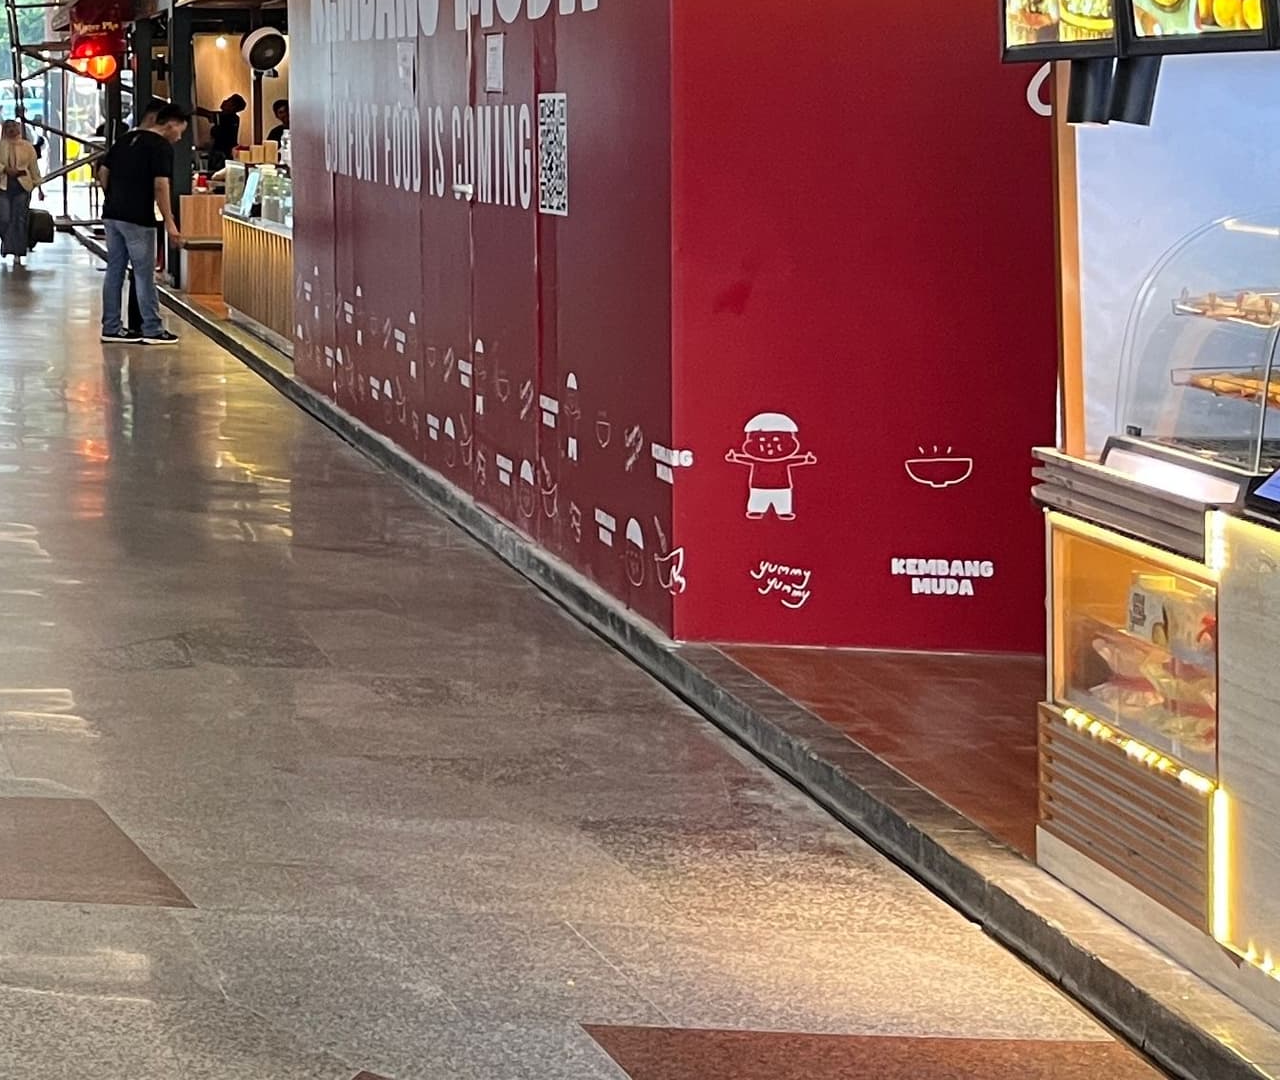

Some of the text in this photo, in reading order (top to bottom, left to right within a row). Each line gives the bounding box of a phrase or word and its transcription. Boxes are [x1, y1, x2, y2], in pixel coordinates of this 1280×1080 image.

[324, 101, 532, 210] COMFORT FOOD IS COMING
[750, 560, 811, 590] yummy
[891, 558, 994, 577] KEMBANG
[758, 577, 811, 609] yummy
[911, 577, 974, 596] MUDA
